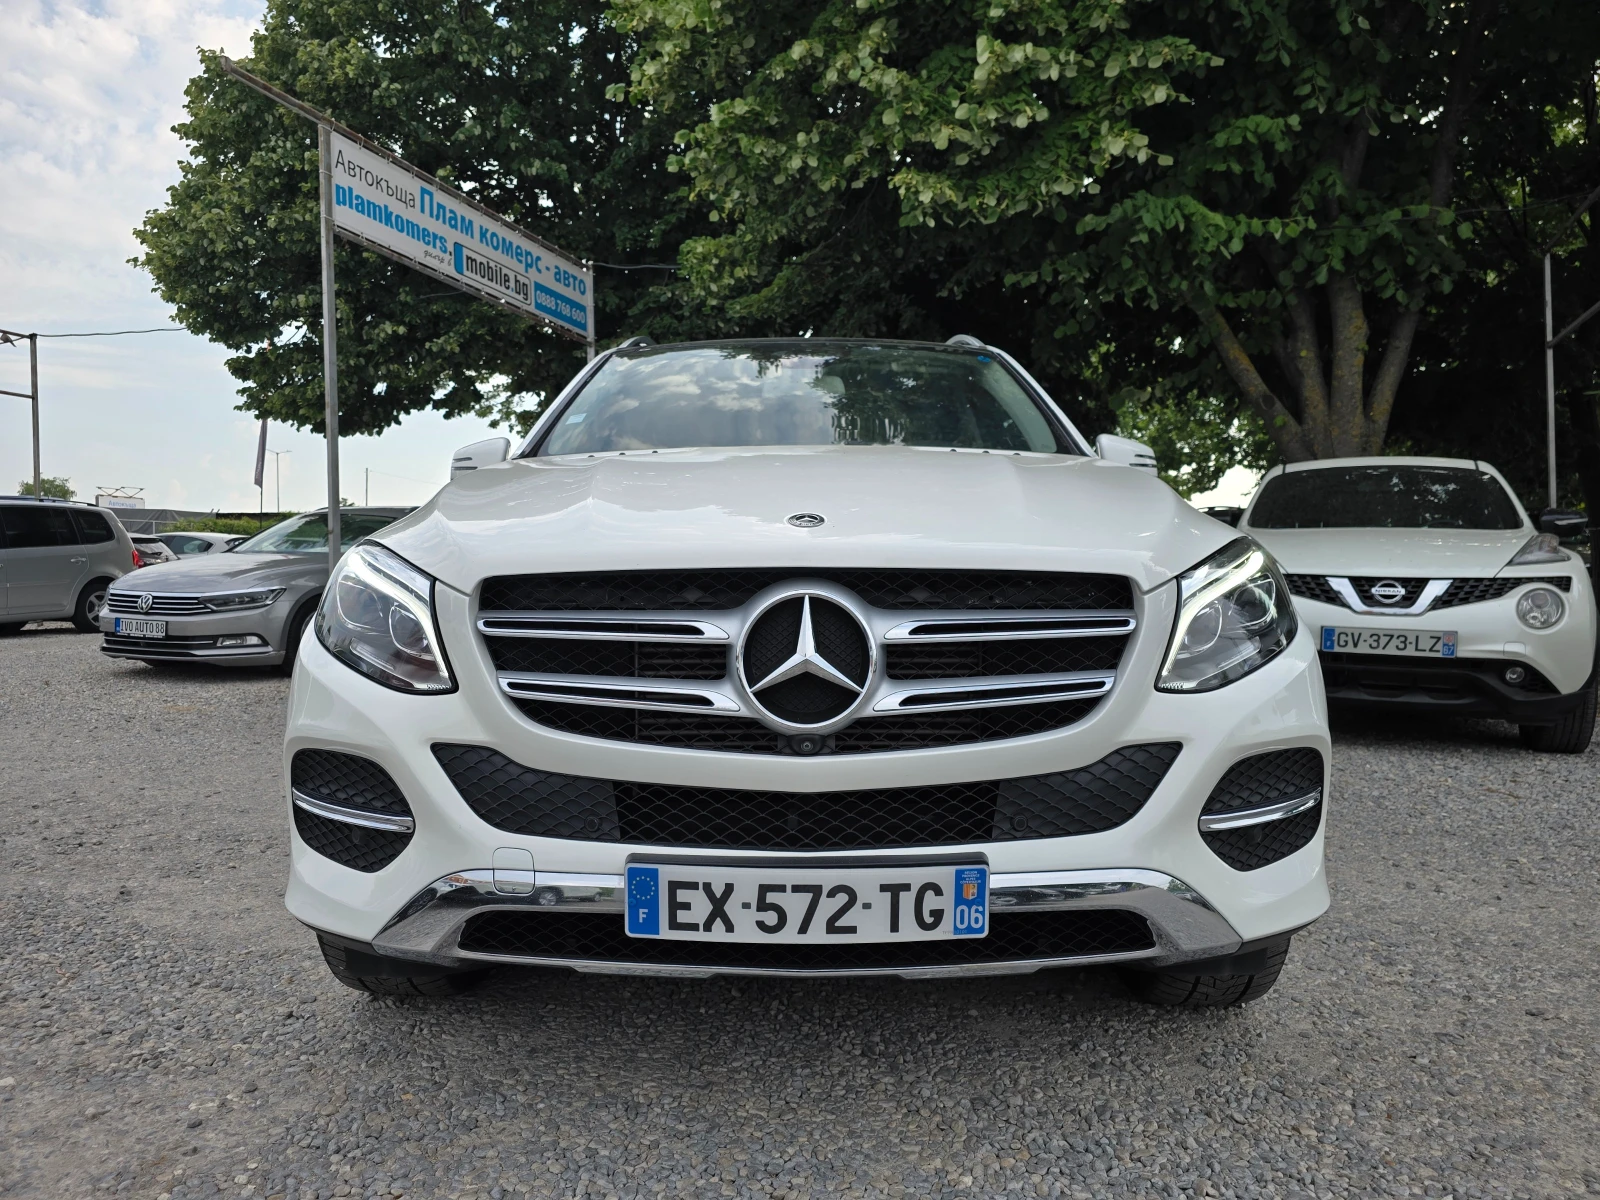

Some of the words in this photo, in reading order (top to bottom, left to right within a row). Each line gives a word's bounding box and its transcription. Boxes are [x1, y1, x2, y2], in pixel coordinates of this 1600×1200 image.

[335, 149, 416, 209] Автокъща
[420, 186, 474, 239] Плам
[479, 225, 542, 273] комерс
[554, 265, 587, 296] авто
[465, 254, 529, 301] mobile.bg
[536, 290, 556, 310] 0888
[557, 300, 571, 317] 768
[572, 309, 586, 324] 600
[120, 620, 134, 632] IVO
[135, 621, 154, 633] AUTO
[155, 622, 165, 634] 88
[1337, 631, 1442, 653] GV-373-LZ
[638, 909, 648, 923] F
[667, 880, 945, 935] EX-572-TG
[955, 904, 984, 929] 06
